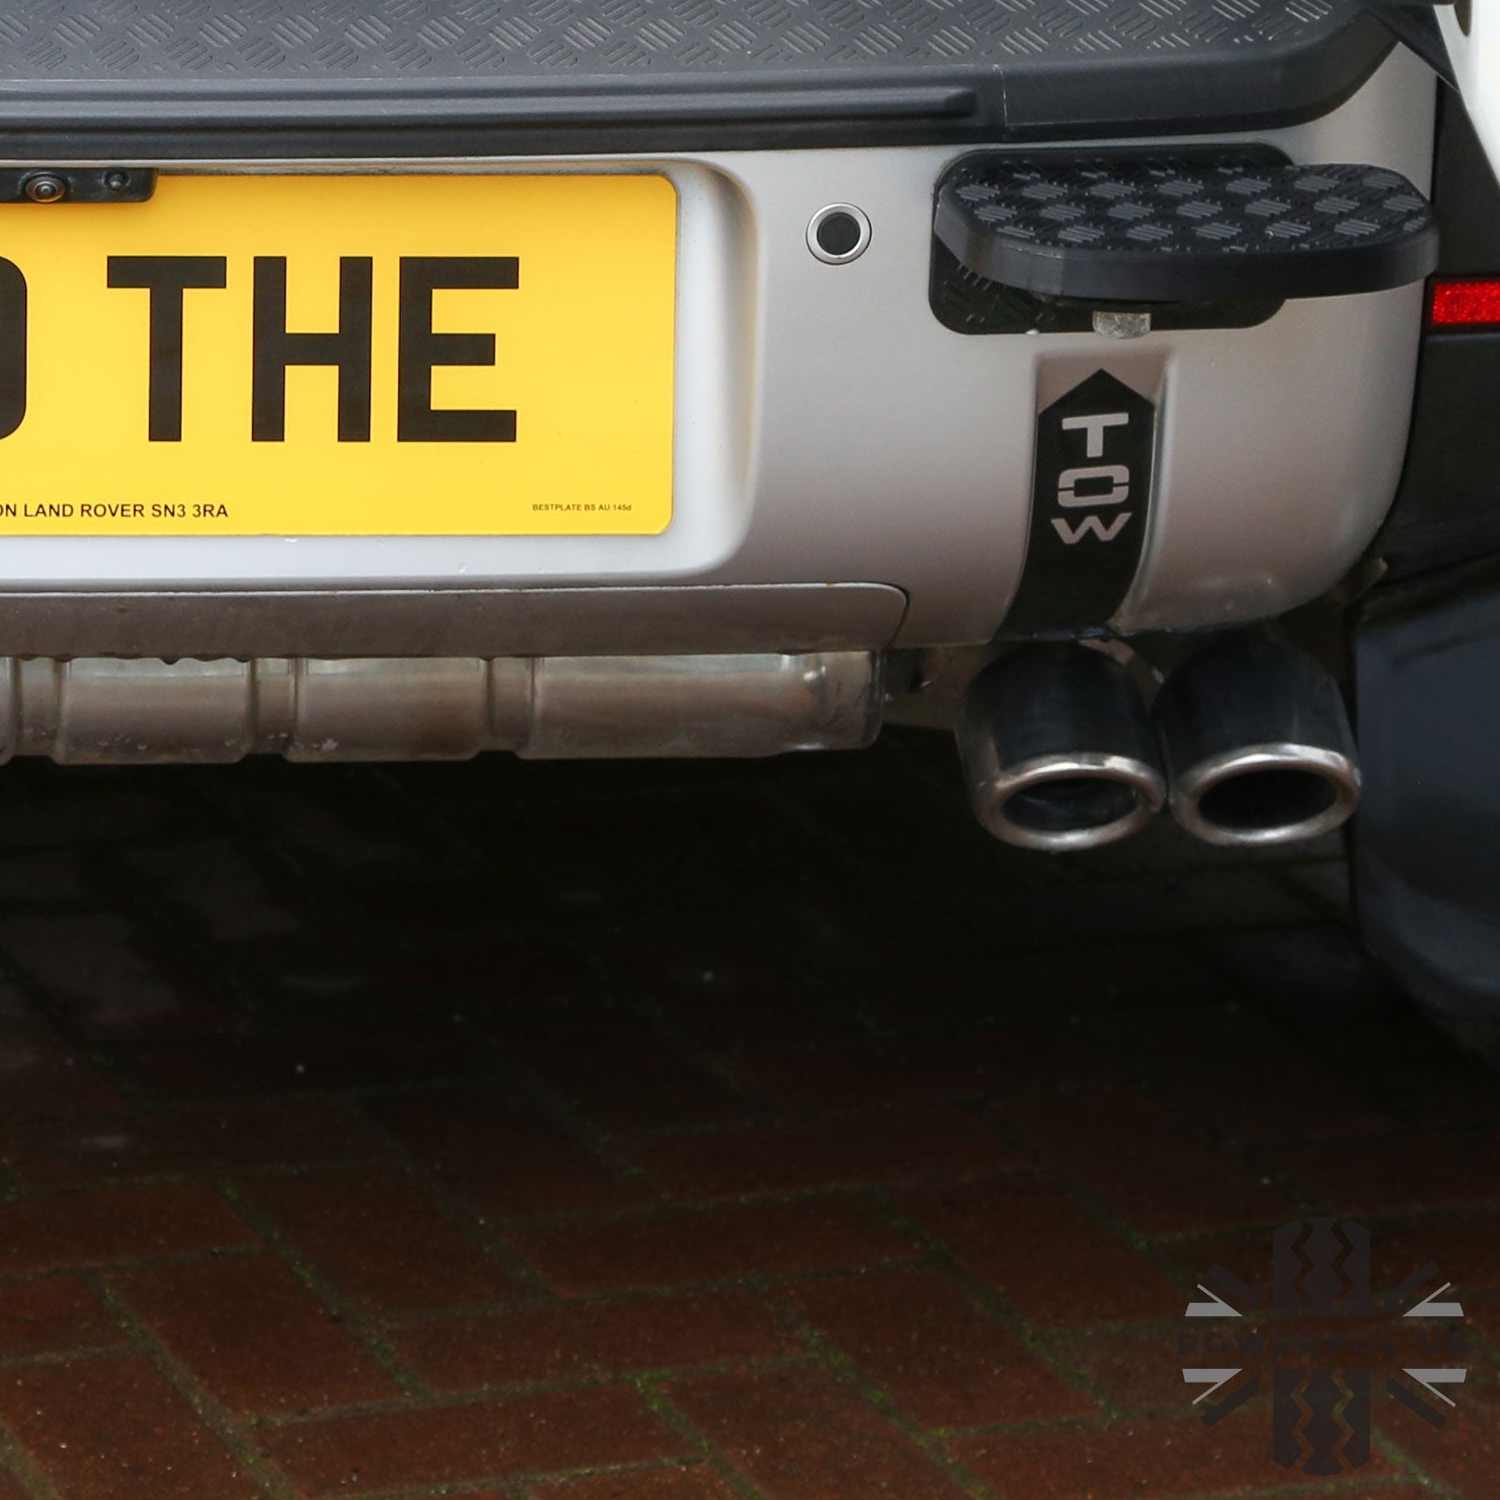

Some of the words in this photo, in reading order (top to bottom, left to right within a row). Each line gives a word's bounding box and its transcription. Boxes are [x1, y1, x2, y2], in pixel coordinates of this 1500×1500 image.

[106, 254, 520, 443] THE
[23, 502, 75, 518] LAND
[79, 503, 146, 519] ROVER
[150, 503, 187, 518] SN3
[192, 503, 229, 519] 3RA
[532, 503, 582, 512] BESTPLATE
[584, 503, 597, 512] BS
[598, 503, 611, 512] AU
[1050, 411, 1133, 545] TOW
